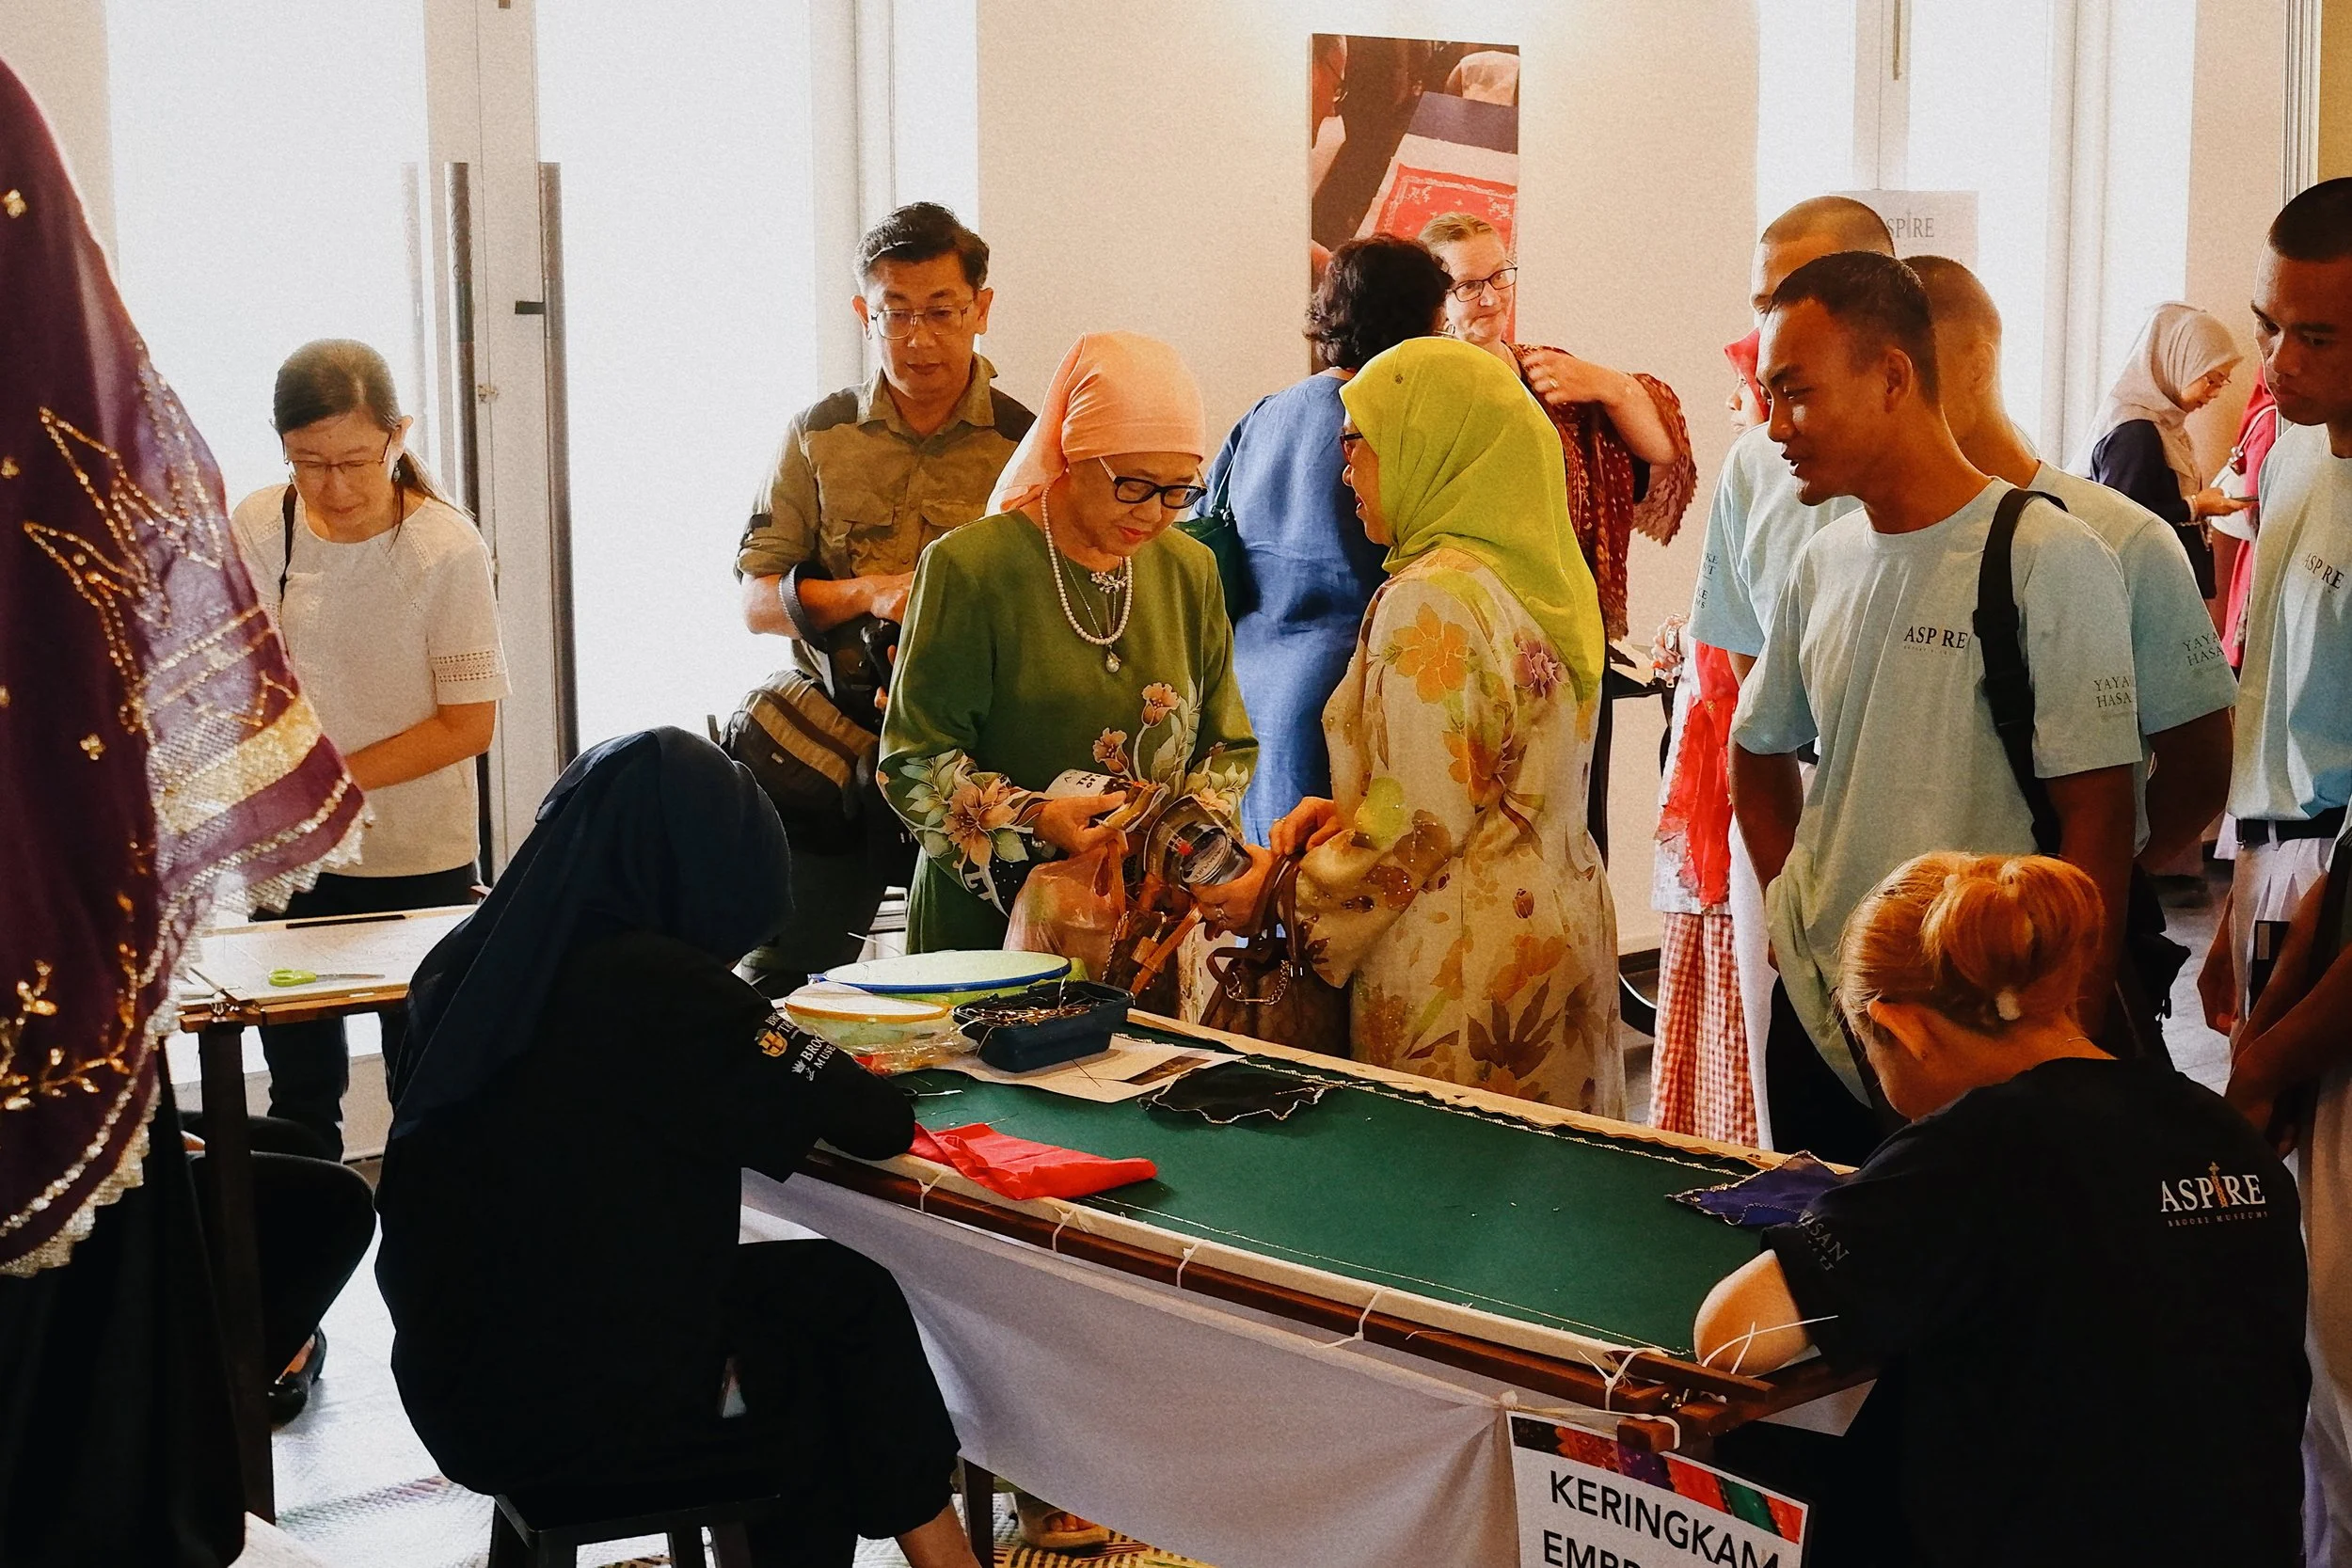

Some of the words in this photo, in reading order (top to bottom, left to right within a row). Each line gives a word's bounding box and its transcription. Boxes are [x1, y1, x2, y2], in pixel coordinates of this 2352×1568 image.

[1886, 211, 1935, 238] SPIRE
[2303, 552, 2344, 589] ASPRE
[1903, 626, 1968, 649] ASPRE
[2160, 1162, 2266, 1212] ASPIRE
